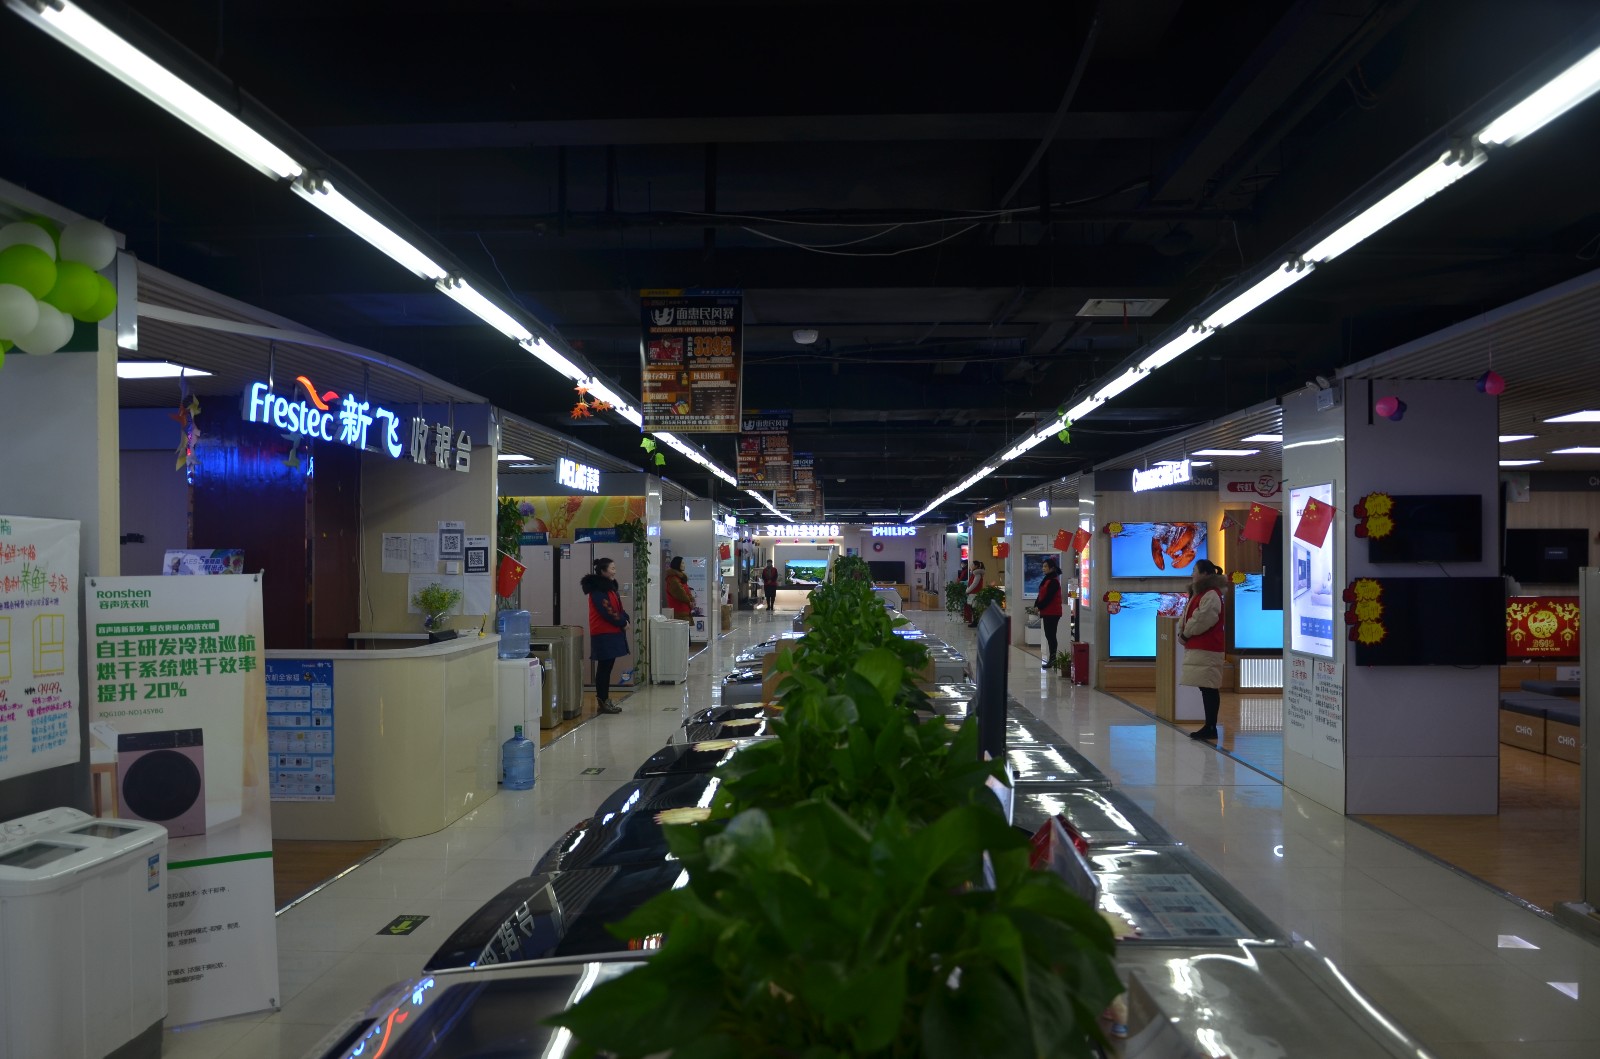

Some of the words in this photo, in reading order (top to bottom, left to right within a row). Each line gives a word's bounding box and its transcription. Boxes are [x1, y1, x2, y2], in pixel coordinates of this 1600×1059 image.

[249, 382, 334, 441] Frestec
[340, 393, 403, 459] 新飞
[411, 416, 472, 473] 收银台
[766, 524, 841, 537] SAMSUNG
[872, 526, 917, 537] PHILIPS
[96, 588, 152, 599] Ronshen
[99, 599, 150, 610] 容声洗衣机
[96, 634, 256, 659] 自主研发冷热巡航
[97, 655, 257, 681] 烘干系统烘干效率
[97, 682, 137, 703] 提升
[143, 681, 187, 700] 20%
